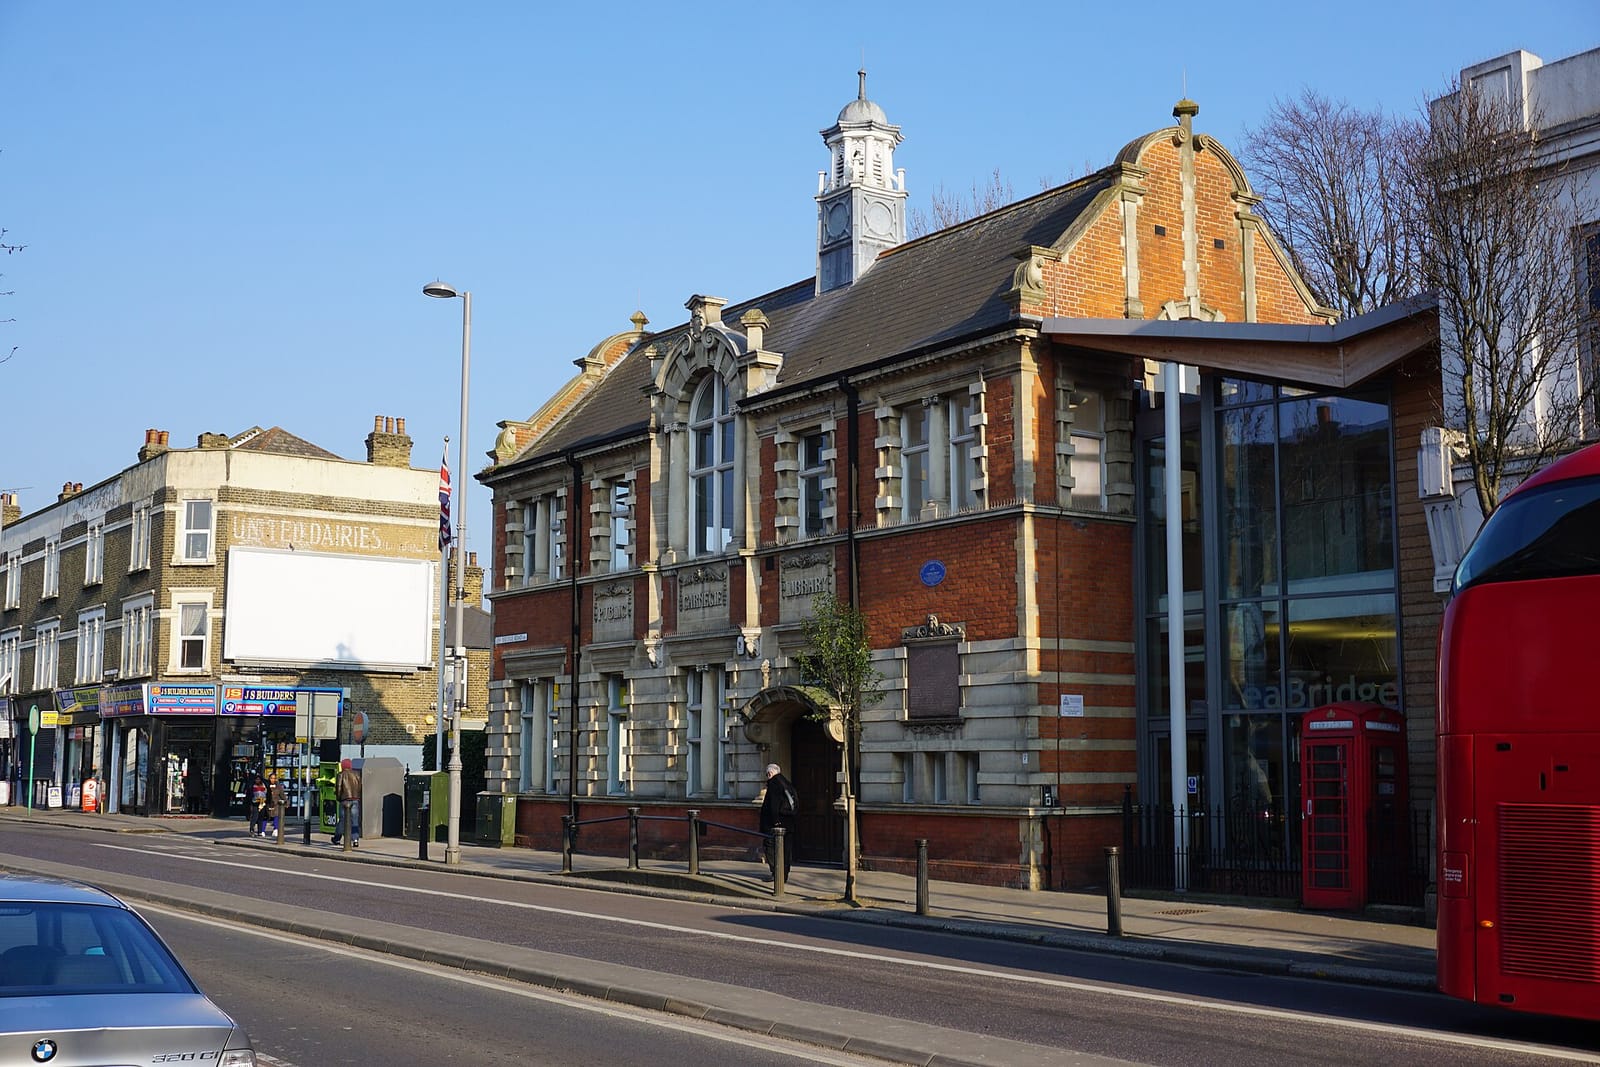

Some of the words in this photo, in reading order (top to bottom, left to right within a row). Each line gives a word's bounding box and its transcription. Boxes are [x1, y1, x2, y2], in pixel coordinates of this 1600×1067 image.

[309, 522, 382, 550] DAIRIES
[785, 576, 828, 597] LIBRARY
[683, 591, 722, 609] CARNEGIE
[598, 606, 628, 620] PUBLIC
[225, 688, 242, 699] JS
[244, 690, 249, 700] J
[250, 690, 256, 700] S
[256, 690, 294, 700] BUILDERS
[152, 1052, 195, 1063] 320
